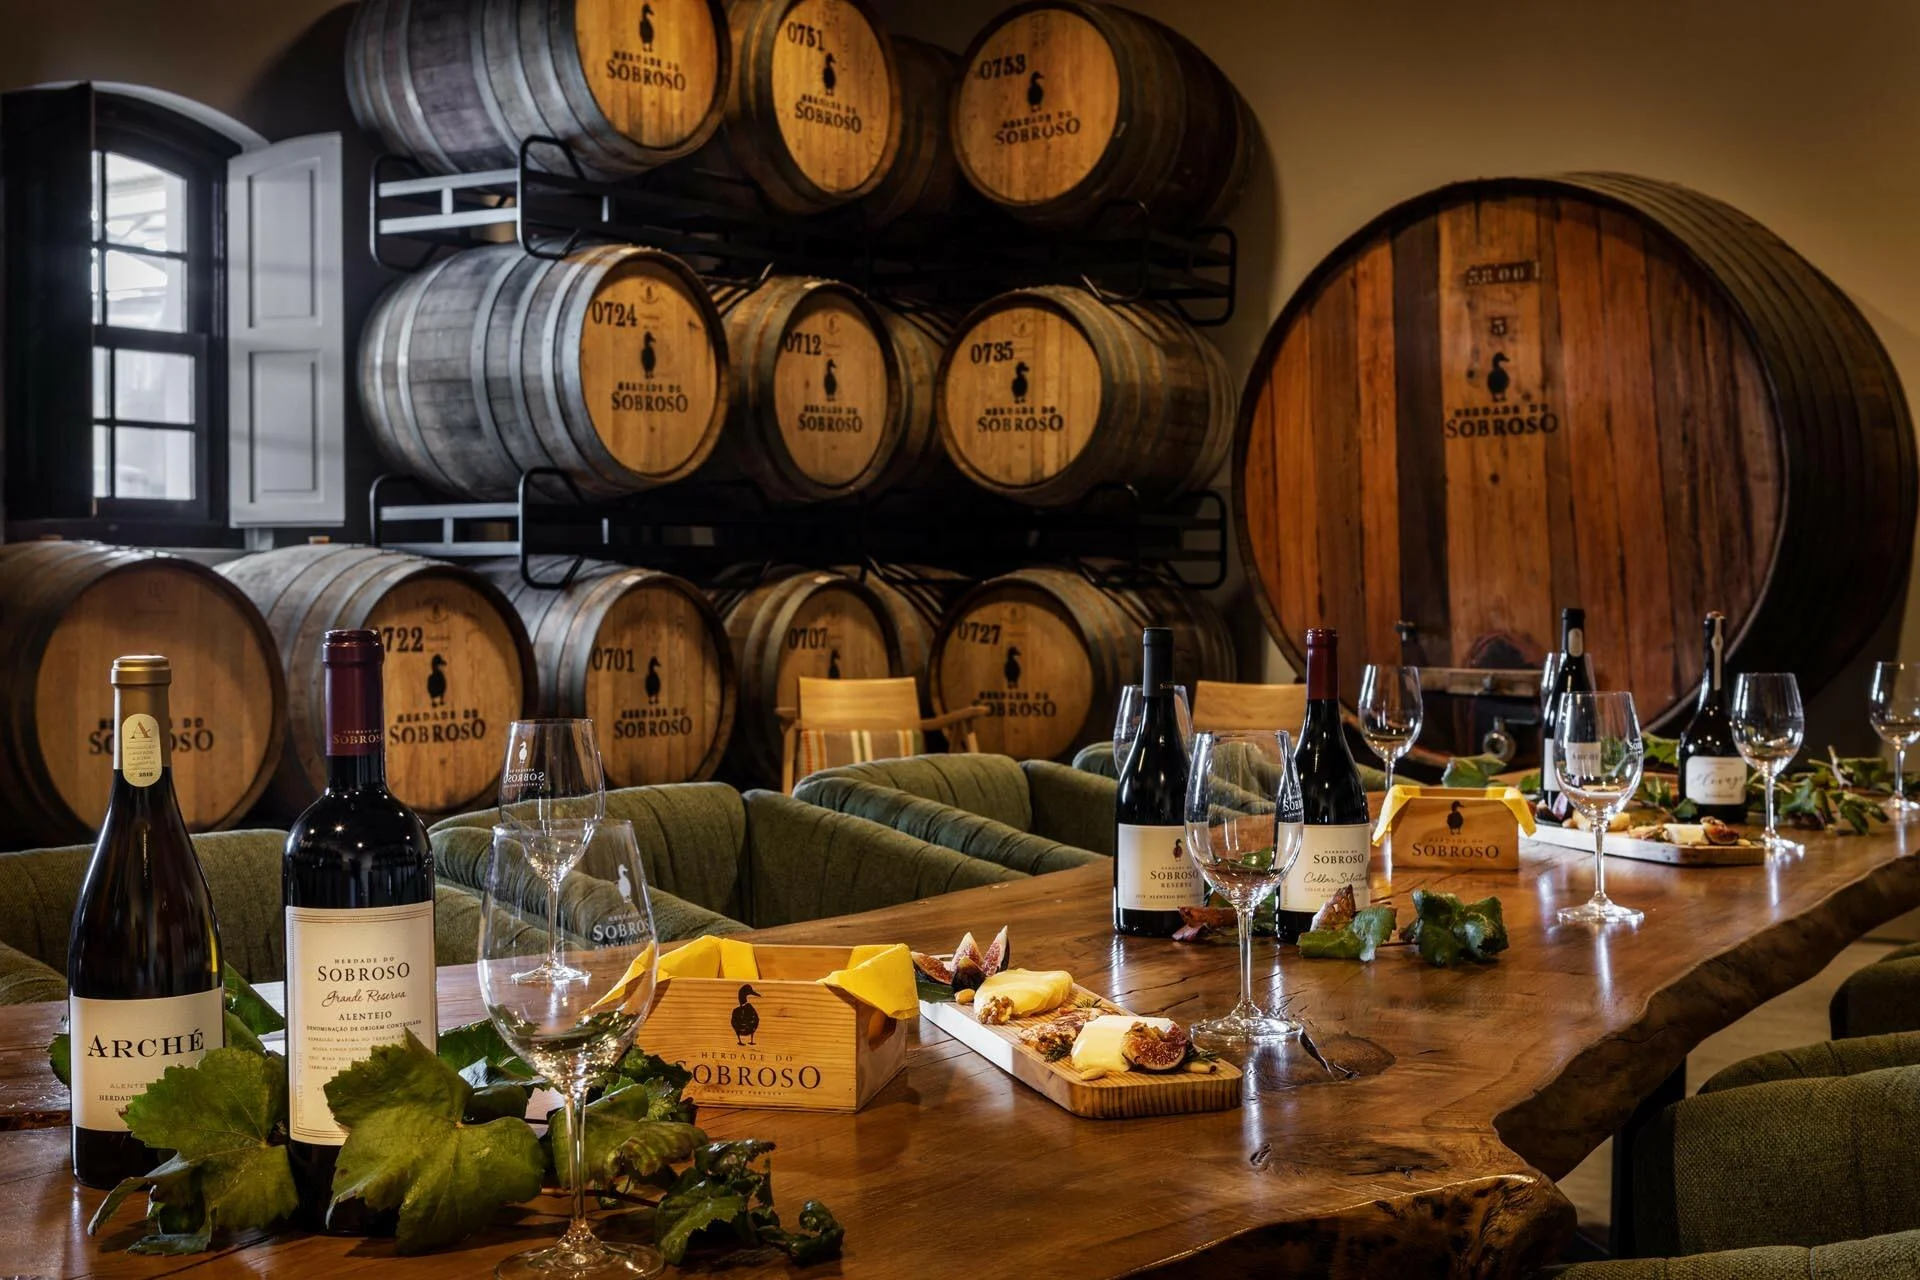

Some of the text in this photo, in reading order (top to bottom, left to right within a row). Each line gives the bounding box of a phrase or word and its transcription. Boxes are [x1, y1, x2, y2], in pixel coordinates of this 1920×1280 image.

[787, 22, 825, 52] 0751
[606, 59, 686, 92] SOBROSO
[795, 101, 862, 134] SOBROSO
[994, 117, 1081, 145] SOBROSO
[592, 300, 637, 327] 0724
[785, 331, 822, 356] 0712
[611, 391, 688, 413] SOBROSO
[797, 412, 863, 433] SOBROSO
[977, 414, 1064, 433] SOBROSO
[1446, 413, 1559, 439] SOBROSO
[381, 626, 424, 653] 722
[788, 627, 828, 650] 0707
[958, 621, 1001, 646] 0727
[592, 647, 635, 673] 0701
[971, 700, 1056, 717] OBROSO
[333, 733, 384, 745] SOBROS
[389, 719, 486, 745] SOBROSO
[614, 716, 692, 739] SOBROSO
[1313, 853, 1364, 864] SOBROSO
[1411, 842, 1499, 859] SOBROSO
[1150, 870, 1199, 880] SOBROSO
[317, 962, 410, 982] SOBROSO
[321, 989, 407, 1008] Grande Reserva
[338, 1010, 393, 1021] ALENTEJO
[87, 1028, 204, 1058] ARCHÉ
[701, 1051, 793, 1062] HERDADE DO
[675, 1060, 821, 1090] OBROSO
[99, 1094, 135, 1102] HERDAD
